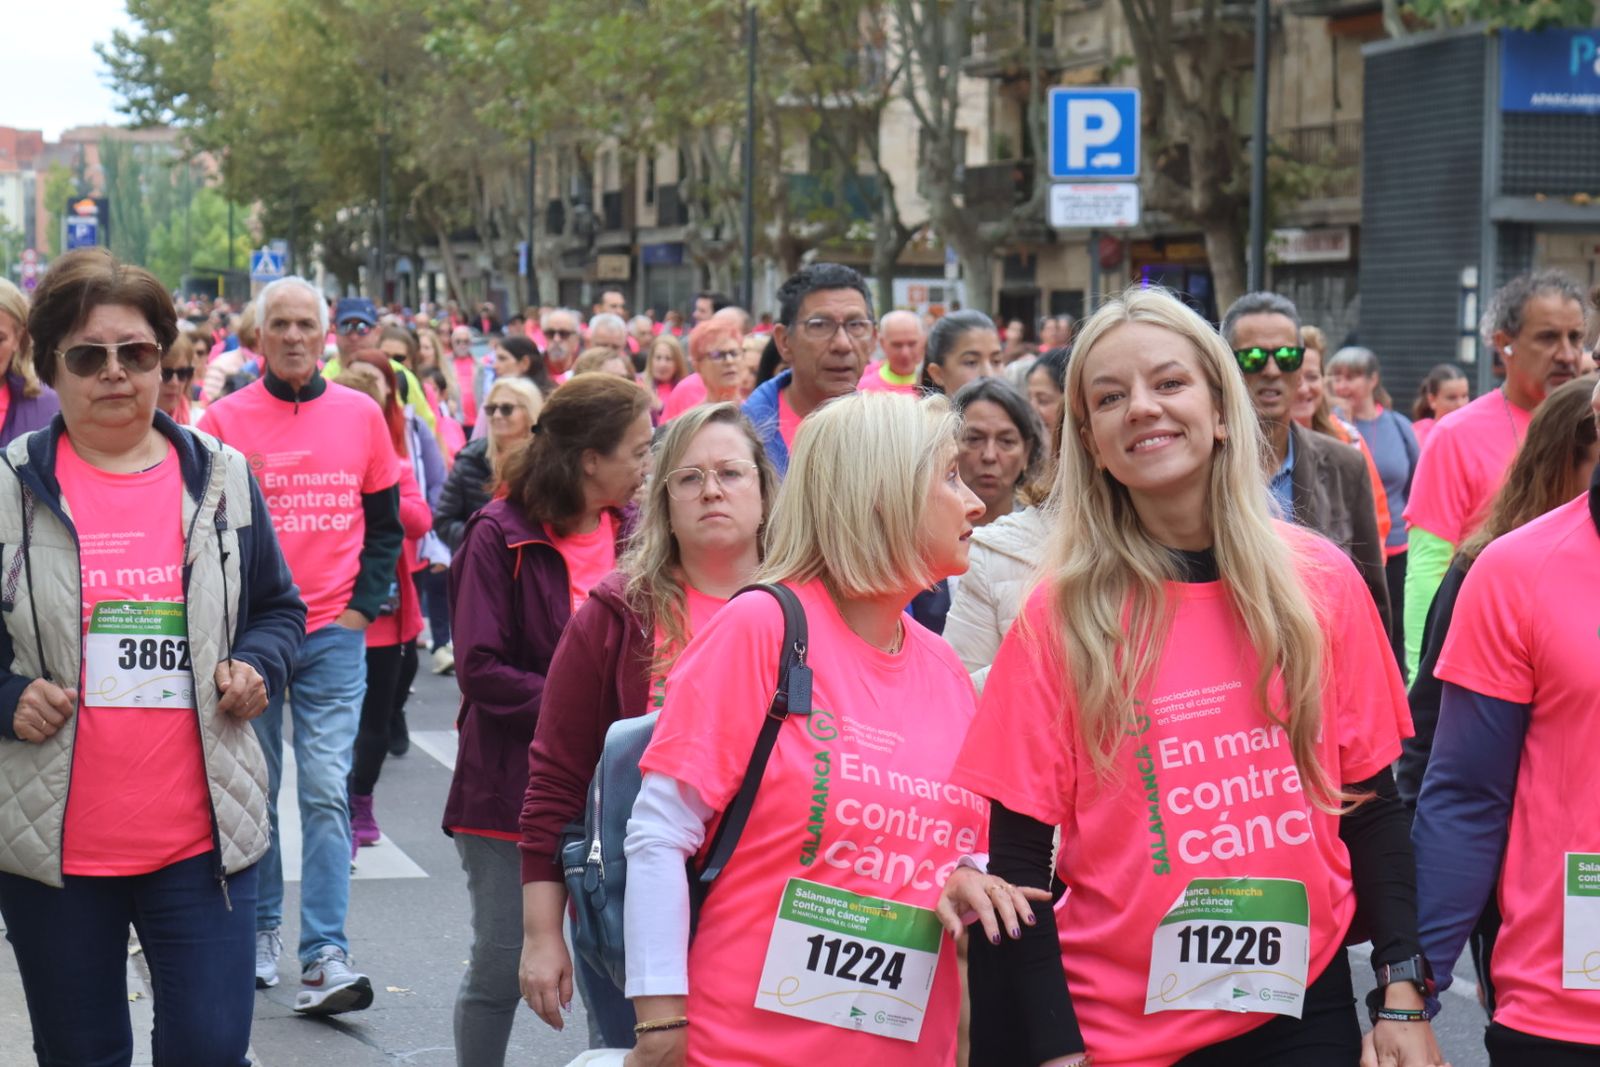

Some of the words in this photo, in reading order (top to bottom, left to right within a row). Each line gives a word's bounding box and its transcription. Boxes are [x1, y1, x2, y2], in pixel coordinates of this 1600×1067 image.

[1067, 98, 1122, 168] P
[264, 473, 288, 488] En
[292, 469, 358, 487] marcha
[265, 489, 337, 508] contra
[338, 489, 355, 508] el
[118, 638, 191, 671] 3862
[1152, 688, 1200, 705] asociación
[1202, 680, 1242, 695] española
[1154, 703, 1185, 715] contra
[1186, 700, 1195, 708] el
[1196, 695, 1226, 706] cáncer
[1158, 717, 1169, 726] en
[1170, 706, 1221, 722] Salamanca
[840, 752, 881, 786] En
[1158, 736, 1206, 770] En
[1166, 763, 1303, 815] contra
[800, 751, 831, 867] SALAMANCA
[835, 798, 953, 849] contra
[1134, 744, 1171, 876] SALAMANCA
[1177, 810, 1316, 865] cánc
[824, 836, 958, 890] cánce
[795, 887, 849, 909] Salamanca
[1190, 897, 1199, 907] el
[1200, 897, 1234, 907] cáncer
[1226, 887, 1263, 897] marcha
[792, 900, 825, 914] contra
[826, 907, 835, 917] el
[837, 909, 870, 925] cáncer
[807, 934, 906, 990] 11224
[1178, 925, 1282, 966] 11226
